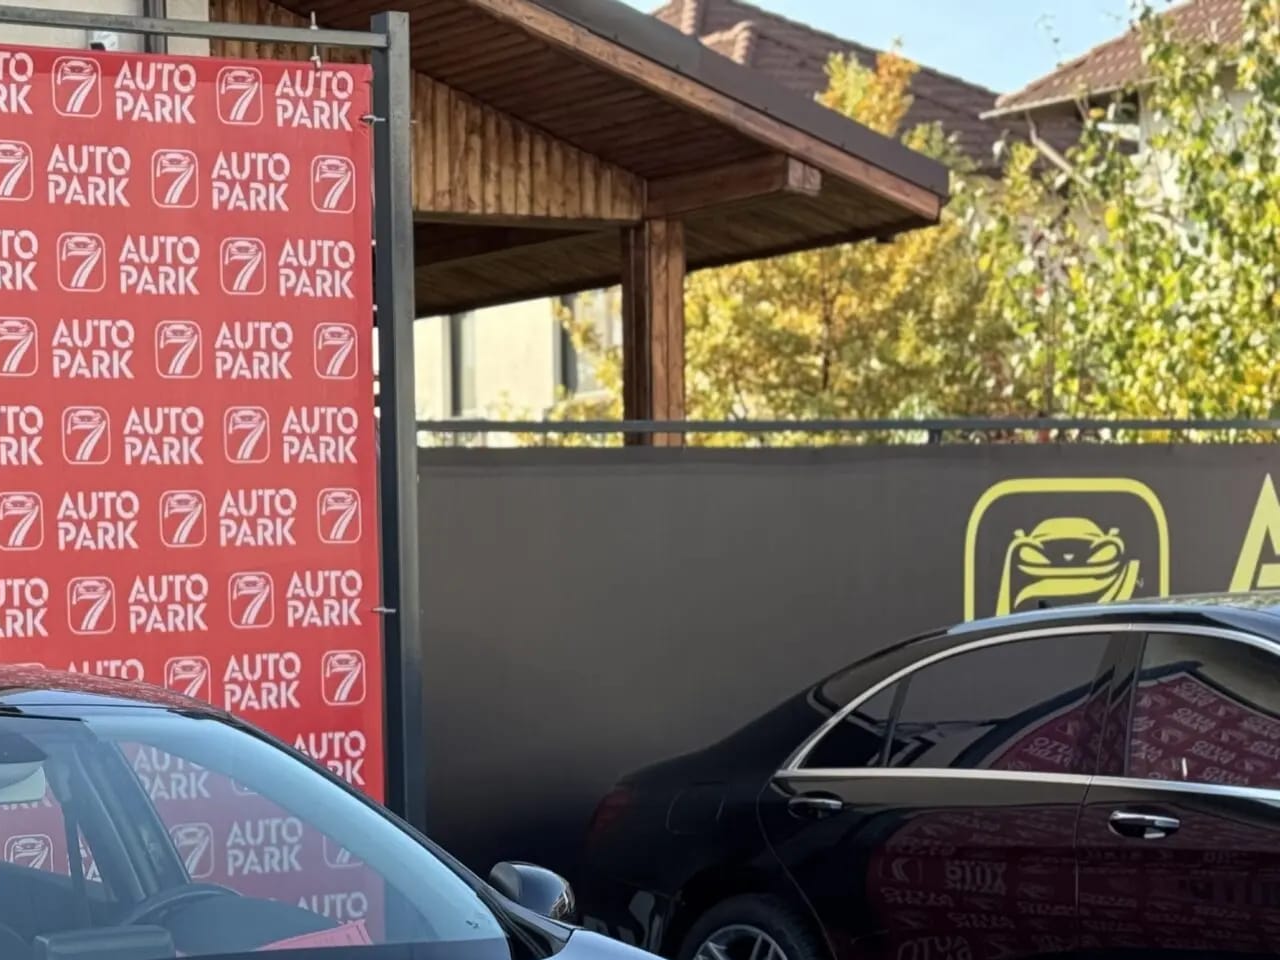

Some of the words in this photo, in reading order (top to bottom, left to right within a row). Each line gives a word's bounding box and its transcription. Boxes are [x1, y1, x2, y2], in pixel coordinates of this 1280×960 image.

[115, 63, 196, 93] AUTO
[275, 70, 353, 99] AUTO
[116, 91, 195, 123] PARK
[276, 99, 352, 131] PARK
[47, 144, 130, 175] AUTO
[211, 152, 290, 181] AUTO
[48, 174, 130, 207] PARK
[212, 181, 289, 211] PARK
[119, 235, 200, 265] AUTO
[278, 239, 355, 268] AUTO
[120, 265, 199, 295] PARK
[280, 268, 354, 298] PARK
[52, 319, 134, 348] AUTO
[215, 322, 293, 350] AUTO
[53, 349, 134, 378] PARK
[216, 351, 292, 379] PARK
[123, 406, 204, 434] AUTO
[282, 407, 358, 434] AUTO
[125, 436, 203, 465] PARK
[283, 436, 357, 463] PARK
[57, 491, 139, 520] AUTO
[219, 488, 297, 517] AUTO
[58, 520, 138, 550] PARK
[220, 517, 296, 546] PARK
[128, 574, 208, 603] AUTO
[287, 570, 362, 598] AUTO
[130, 603, 208, 633] PARK
[288, 598, 361, 627] PARK
[224, 652, 301, 681] AUTO
[224, 682, 300, 711] PARK
[226, 818, 303, 846] AUTO
[227, 844, 303, 875] PARK
